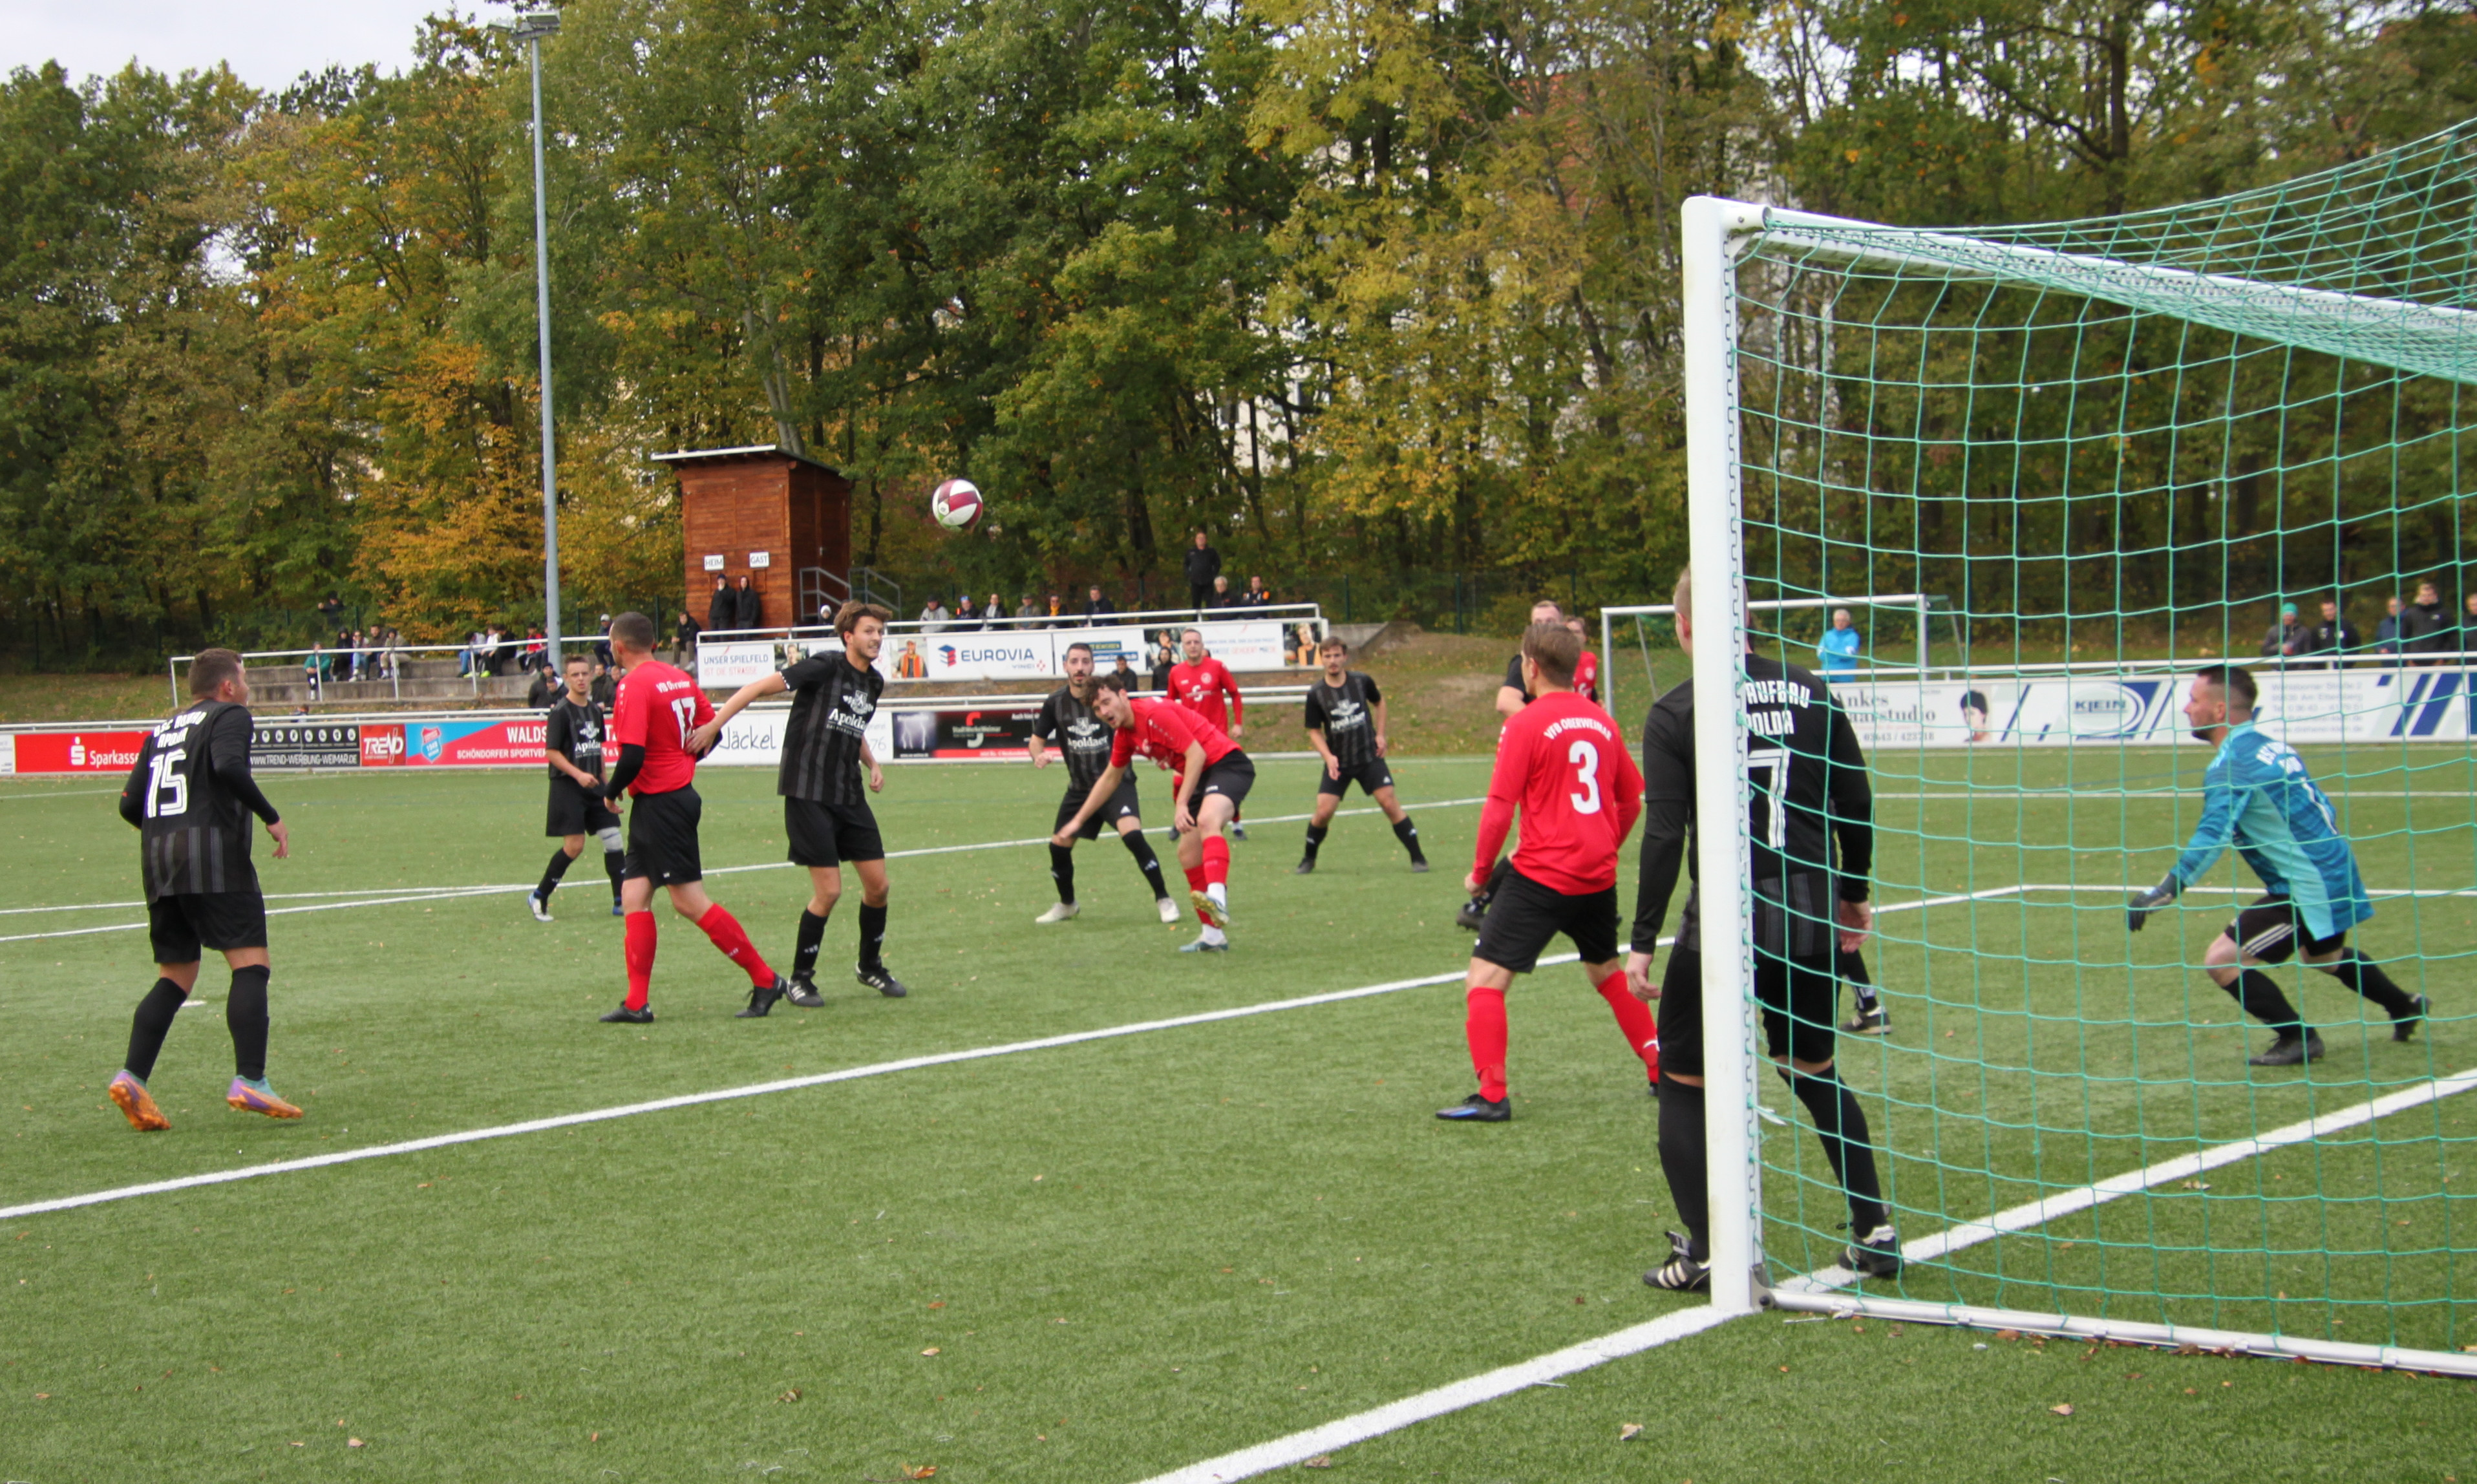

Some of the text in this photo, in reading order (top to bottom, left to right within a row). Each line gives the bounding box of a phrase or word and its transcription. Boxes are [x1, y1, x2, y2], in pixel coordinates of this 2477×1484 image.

[703, 653, 769, 664] UNSER SPIELFELD
[961, 648, 1035, 662] EUROVIA
[704, 665, 758, 676] IST DIE STRASSE
[1834, 688, 1889, 708] Ankes
[671, 696, 697, 750] 17
[828, 708, 867, 730] Apolda
[1746, 710, 1795, 737] POLDA
[1849, 704, 1936, 723] aarstudio
[719, 724, 776, 750] Jäckel
[1543, 717, 1613, 741] VFB OBERWEIMAR
[363, 732, 404, 755] TREND
[456, 747, 509, 759] SCHÖNDORFER
[147, 748, 188, 819] 15
[1568, 740, 1602, 815] 3
[1747, 748, 1791, 849] 7
